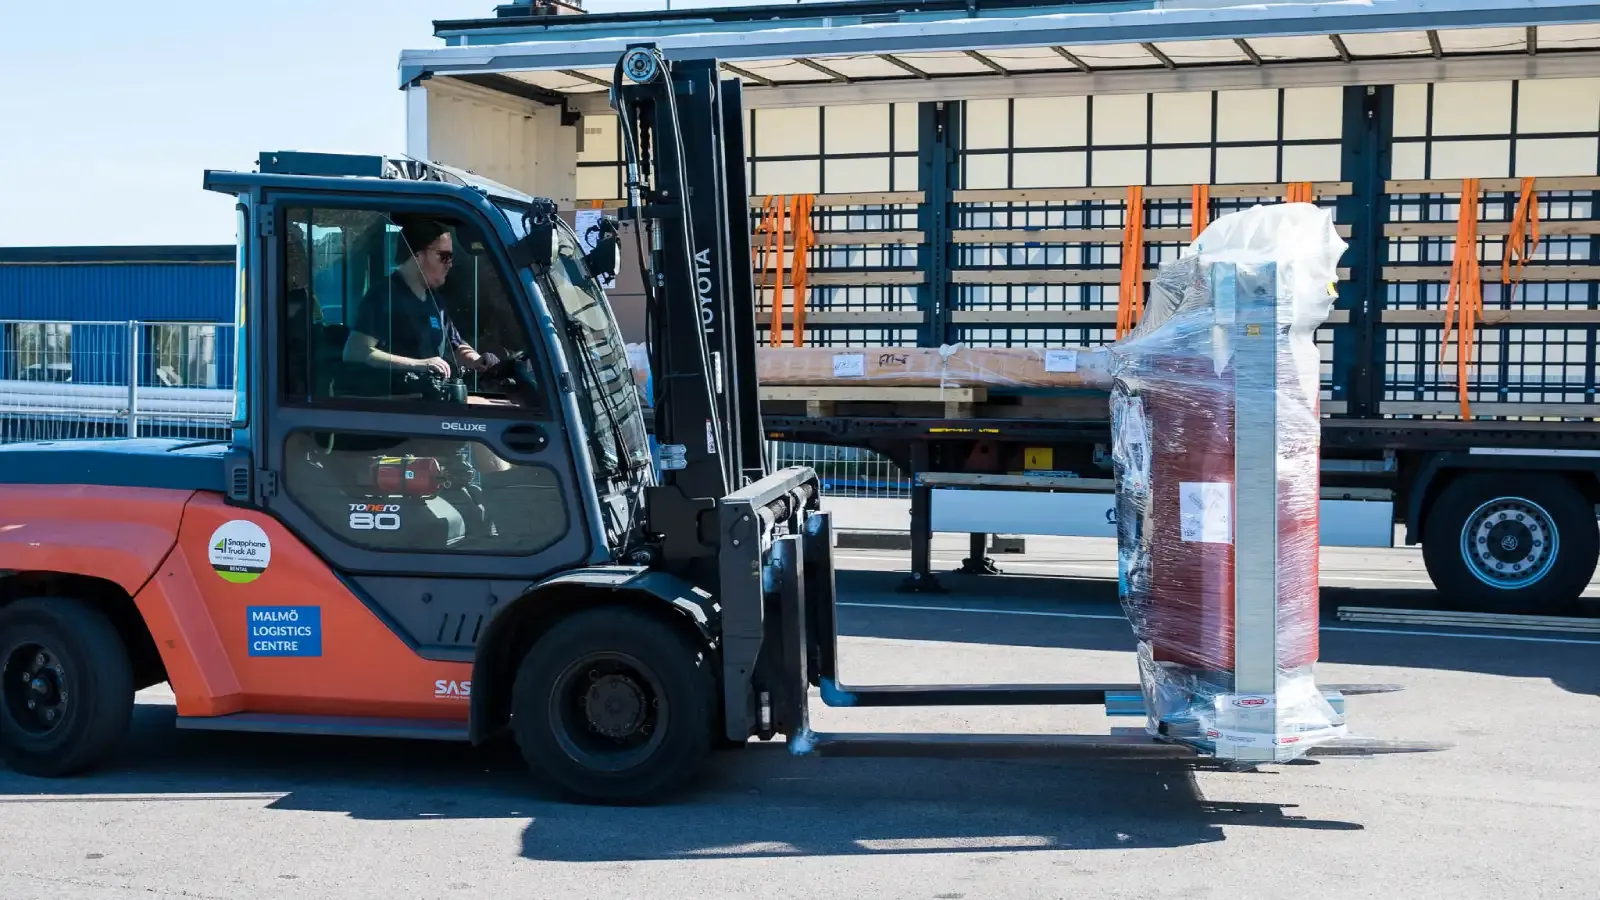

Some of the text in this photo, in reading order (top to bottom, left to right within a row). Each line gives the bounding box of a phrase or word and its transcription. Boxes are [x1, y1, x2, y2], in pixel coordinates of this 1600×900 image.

[441, 422, 487, 431] DELUXE
[350, 513, 400, 529] 80
[228, 538, 266, 548] Snapphane
[228, 547, 256, 556] Truck AB
[252, 609, 298, 621] MALMÖ
[253, 626, 312, 636] LOGISTICS
[253, 641, 298, 651] CENTRE
[435, 680, 471, 695] SAS
